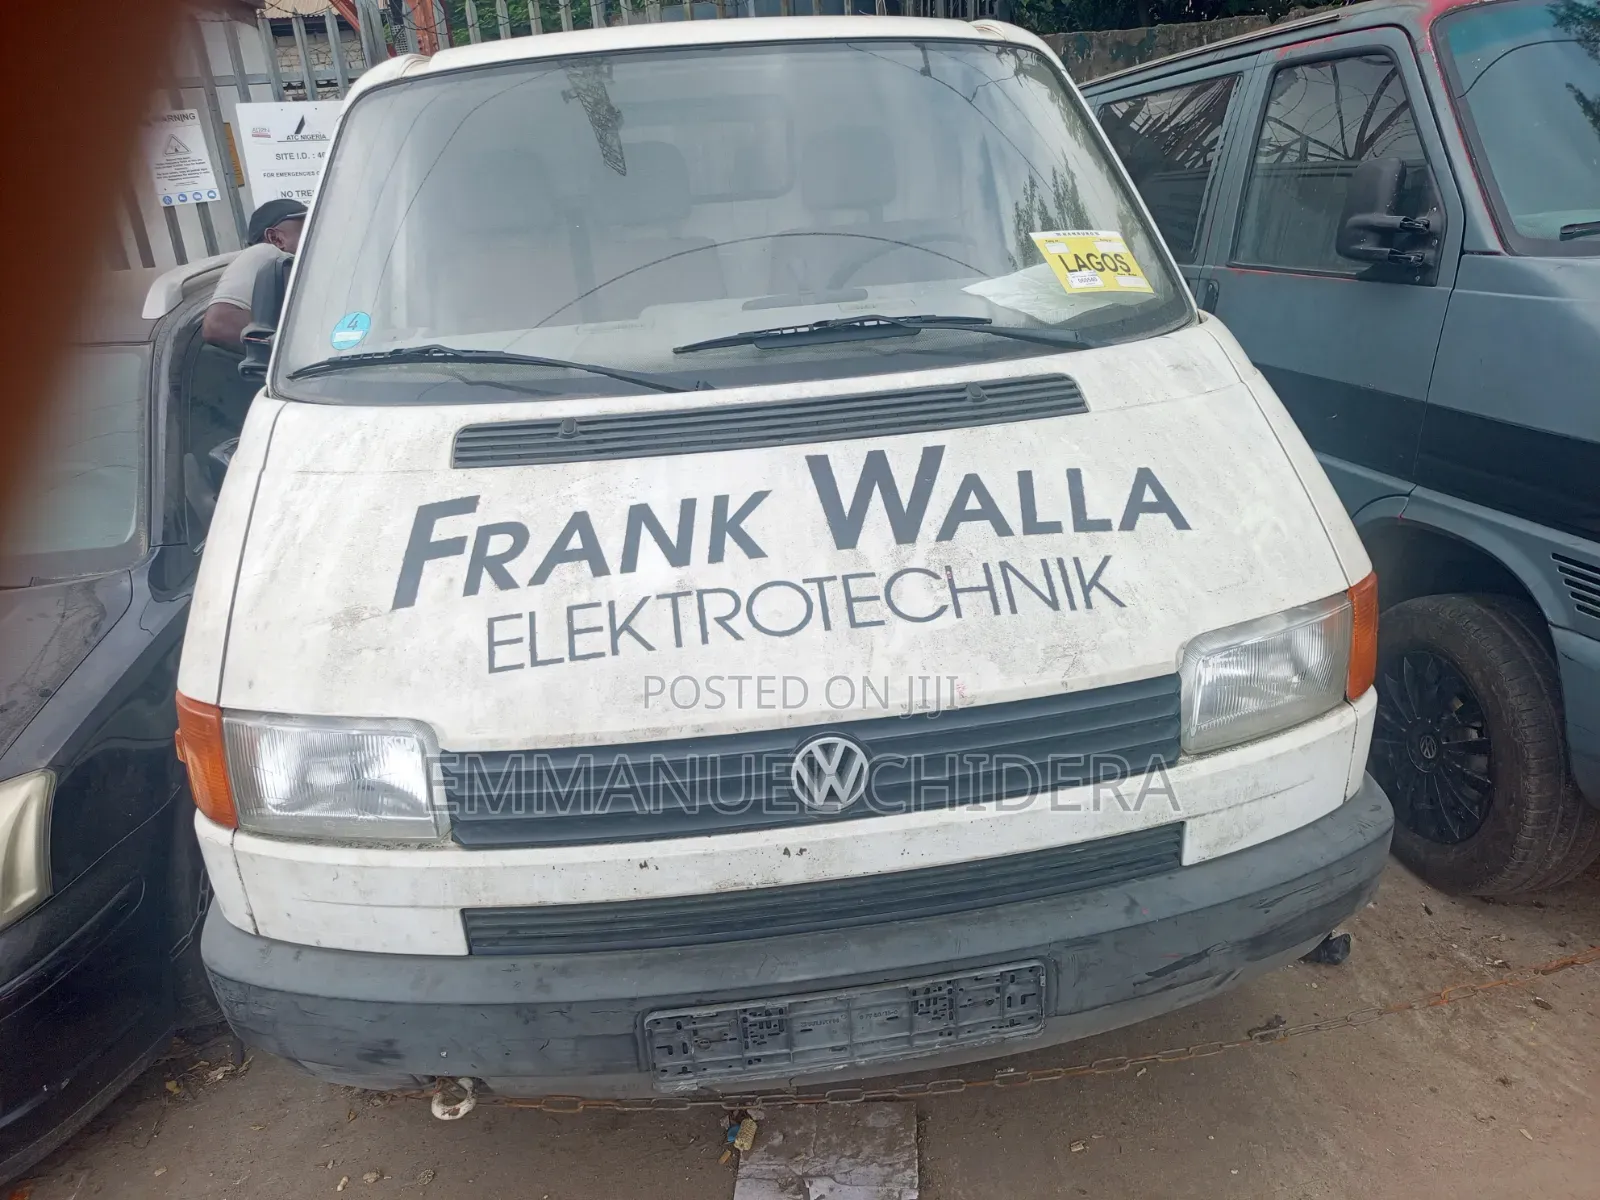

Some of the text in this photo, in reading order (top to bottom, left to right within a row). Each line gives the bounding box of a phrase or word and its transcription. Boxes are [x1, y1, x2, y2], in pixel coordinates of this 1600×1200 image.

[275, 152, 295, 161] SITE
[276, 170, 316, 178] EMERGENCIES
[280, 189, 315, 198] NO TRE
[1057, 252, 1132, 273] LAGOS
[346, 313, 360, 331] 4
[391, 444, 1193, 611] FRANK WALLA
[487, 555, 1127, 674] ELEKTROTECHNIK
[790, 735, 870, 813] VW
